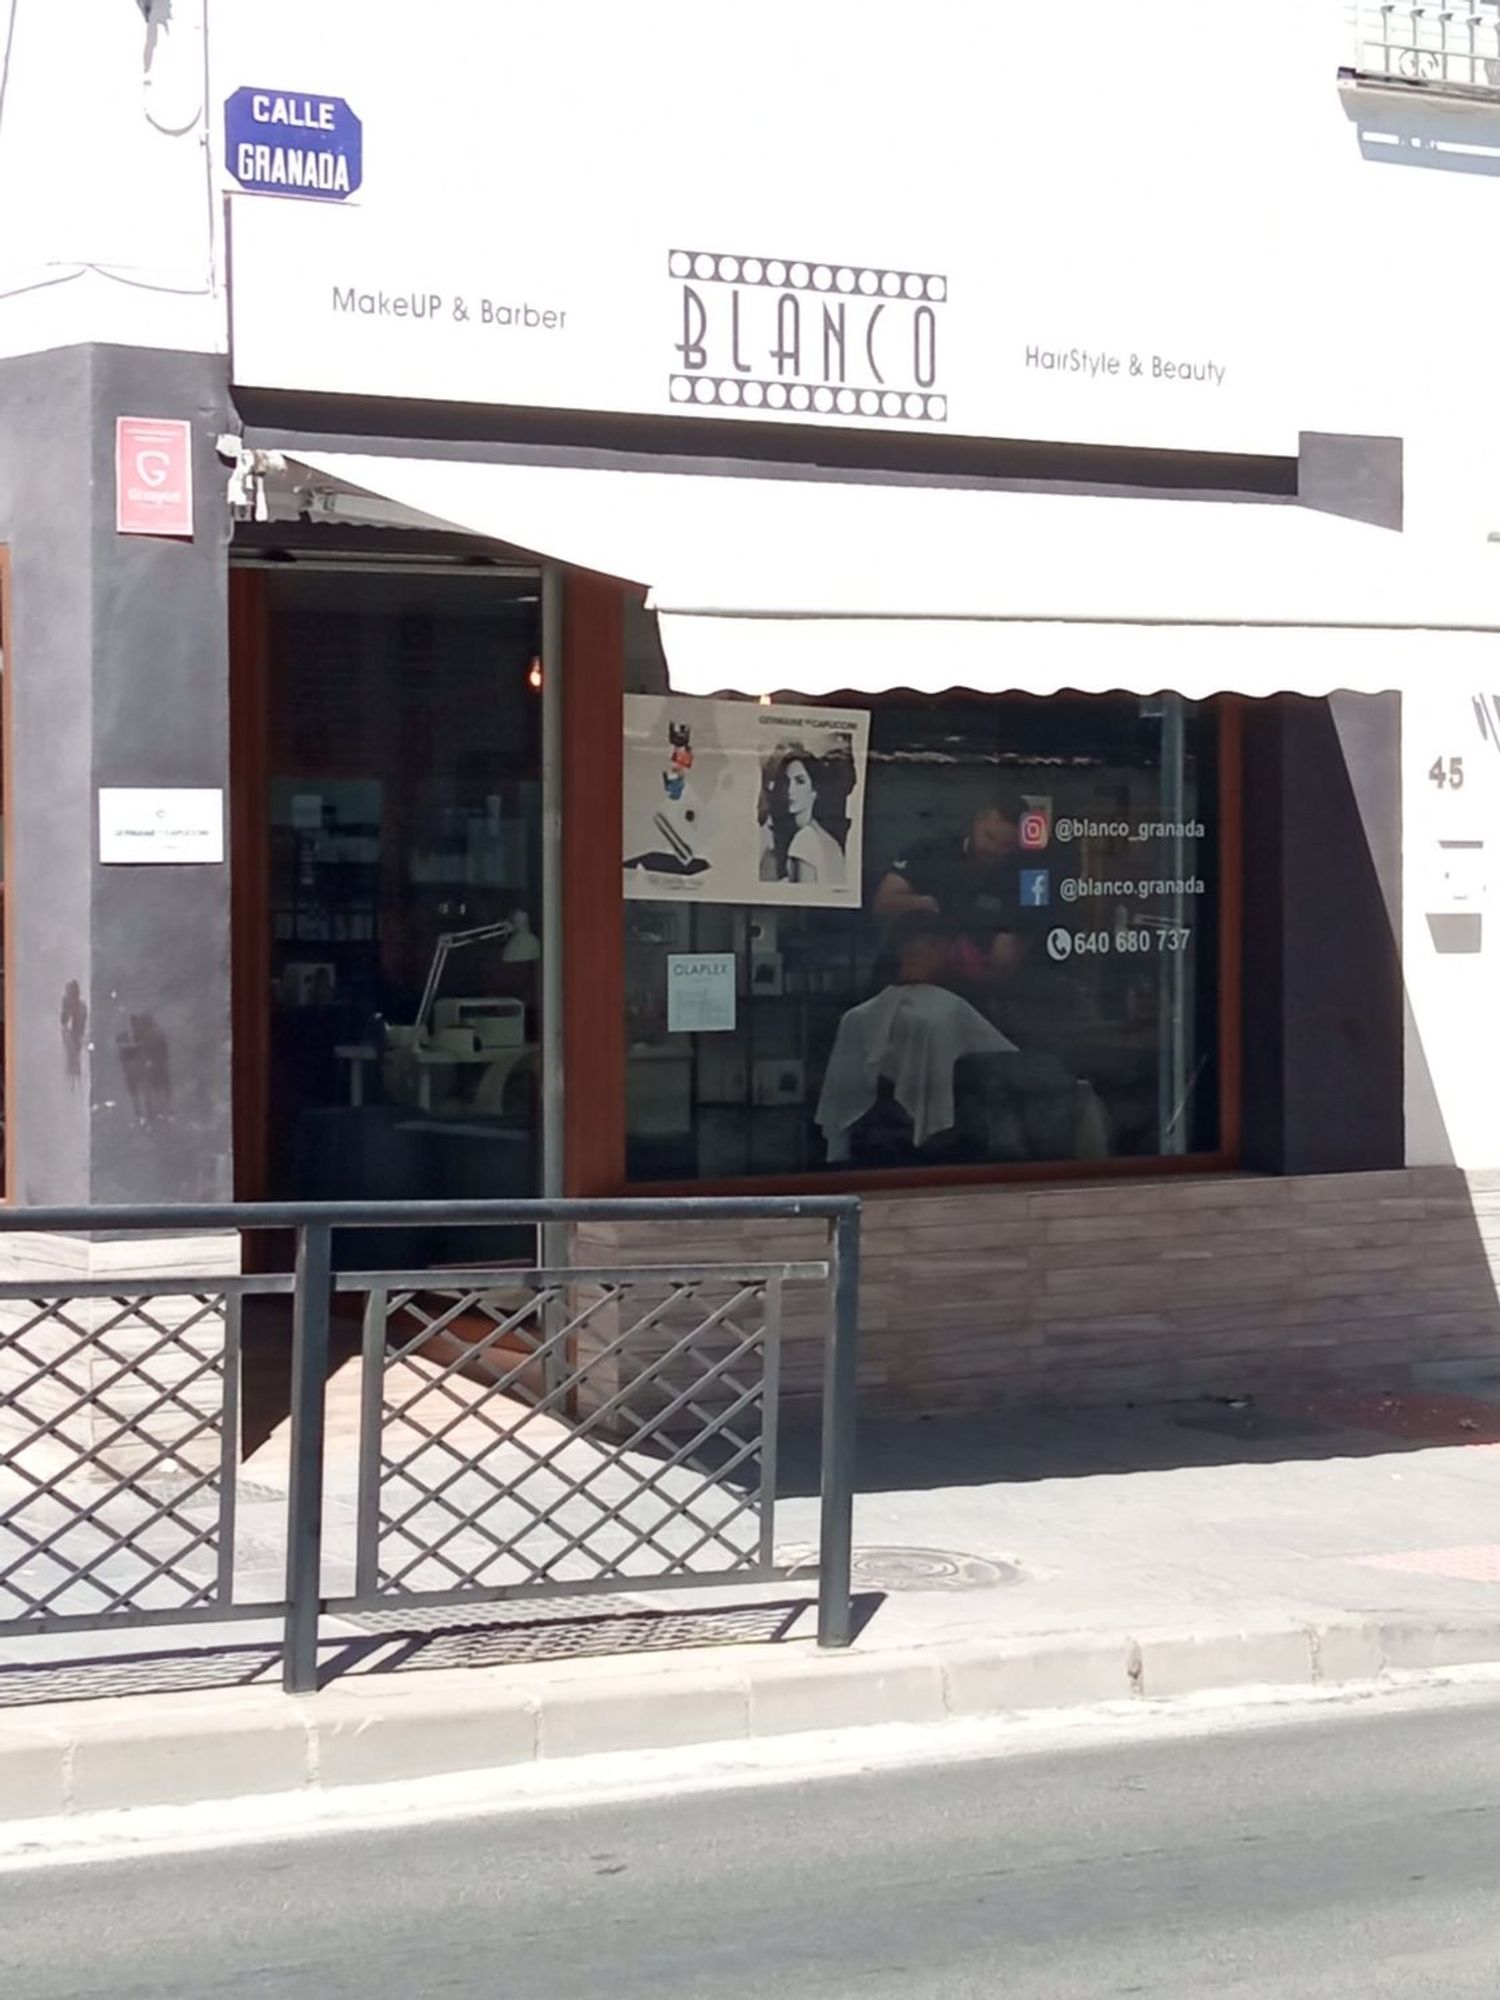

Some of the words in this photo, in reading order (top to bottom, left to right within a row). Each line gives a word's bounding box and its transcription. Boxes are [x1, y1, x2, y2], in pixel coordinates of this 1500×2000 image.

[252, 94, 336, 131] CALLE
[237, 142, 350, 192] GRANADA
[332, 286, 442, 319] MakeUP
[452, 296, 471, 322] &
[481, 298, 567, 329] Barber
[674, 284, 936, 389] BLANCO
[1025, 345, 1120, 378] HairStyle
[1129, 352, 1144, 377] &
[1152, 355, 1226, 386] Beauty
[1428, 755, 1464, 790] 45
[1055, 818, 1206, 842] @blanco_granada
[1060, 876, 1206, 902] @blanco.granada
[1074, 932, 1110, 954] 640
[1115, 930, 1150, 952] 680
[1156, 929, 1191, 951] 737
[673, 963, 728, 976] OLAPLEX
